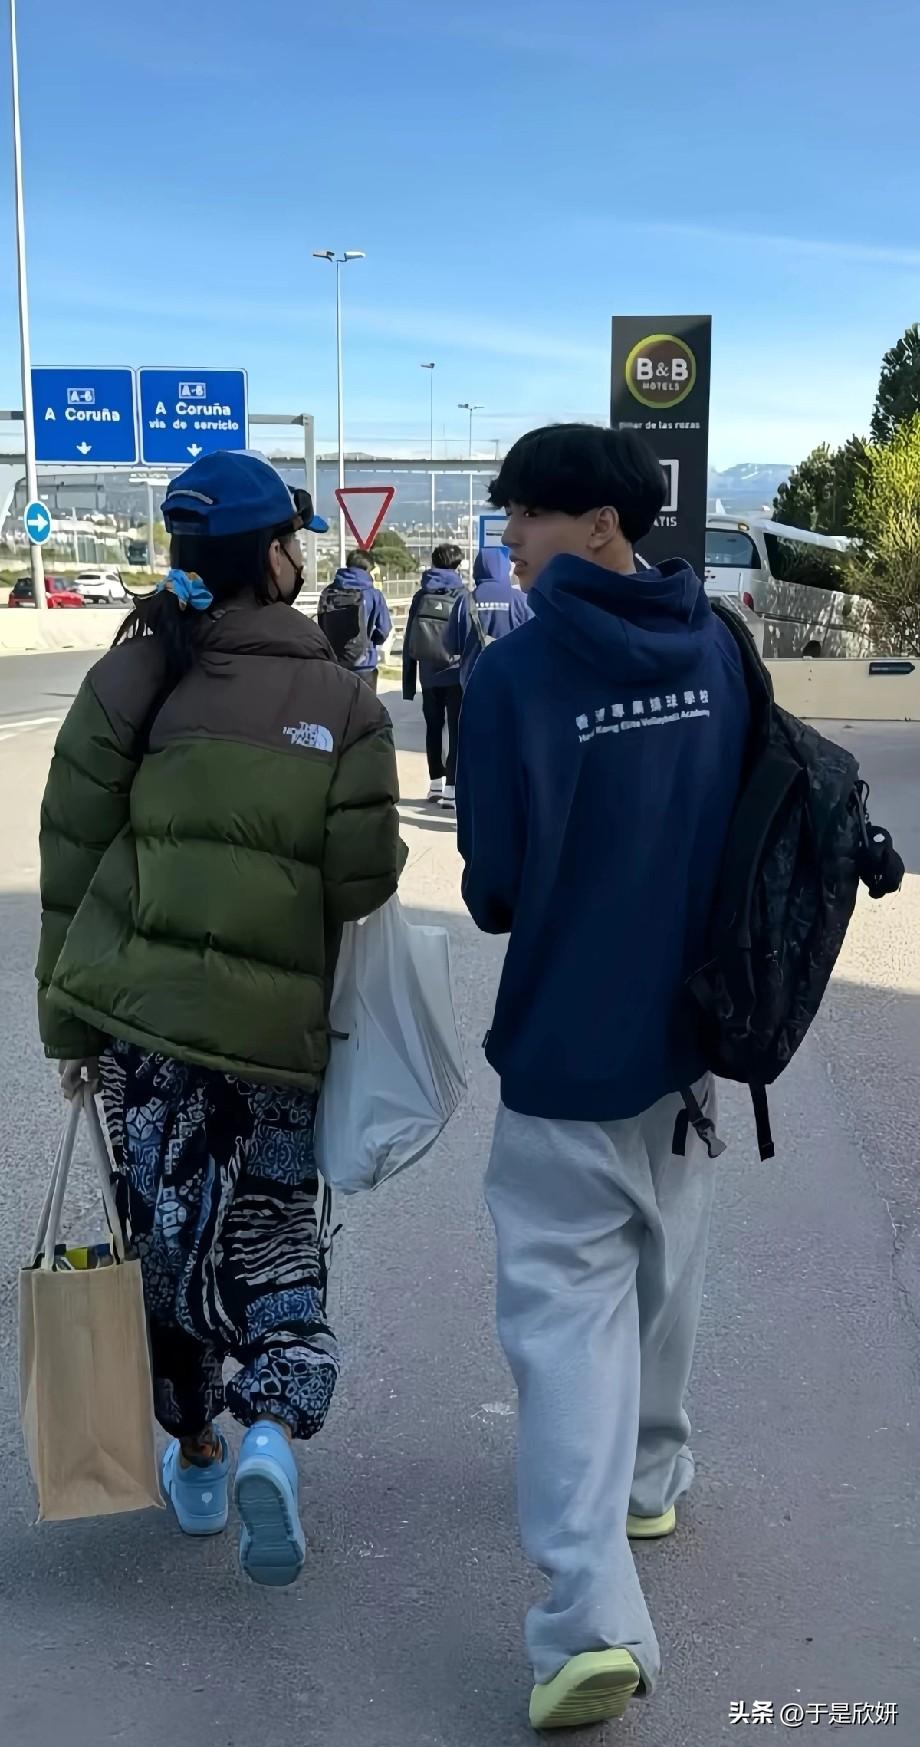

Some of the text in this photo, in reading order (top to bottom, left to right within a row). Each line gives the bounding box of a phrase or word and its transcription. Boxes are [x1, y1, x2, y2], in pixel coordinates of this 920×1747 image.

[636, 357, 689, 381] B&B
[70, 390, 93, 403] A-6
[44, 407, 121, 422] A Coruña
[155, 401, 231, 416] A Coruña
[172, 418, 188, 431] de
[193, 419, 239, 431] servicio
[653, 516, 678, 527] ATIS
